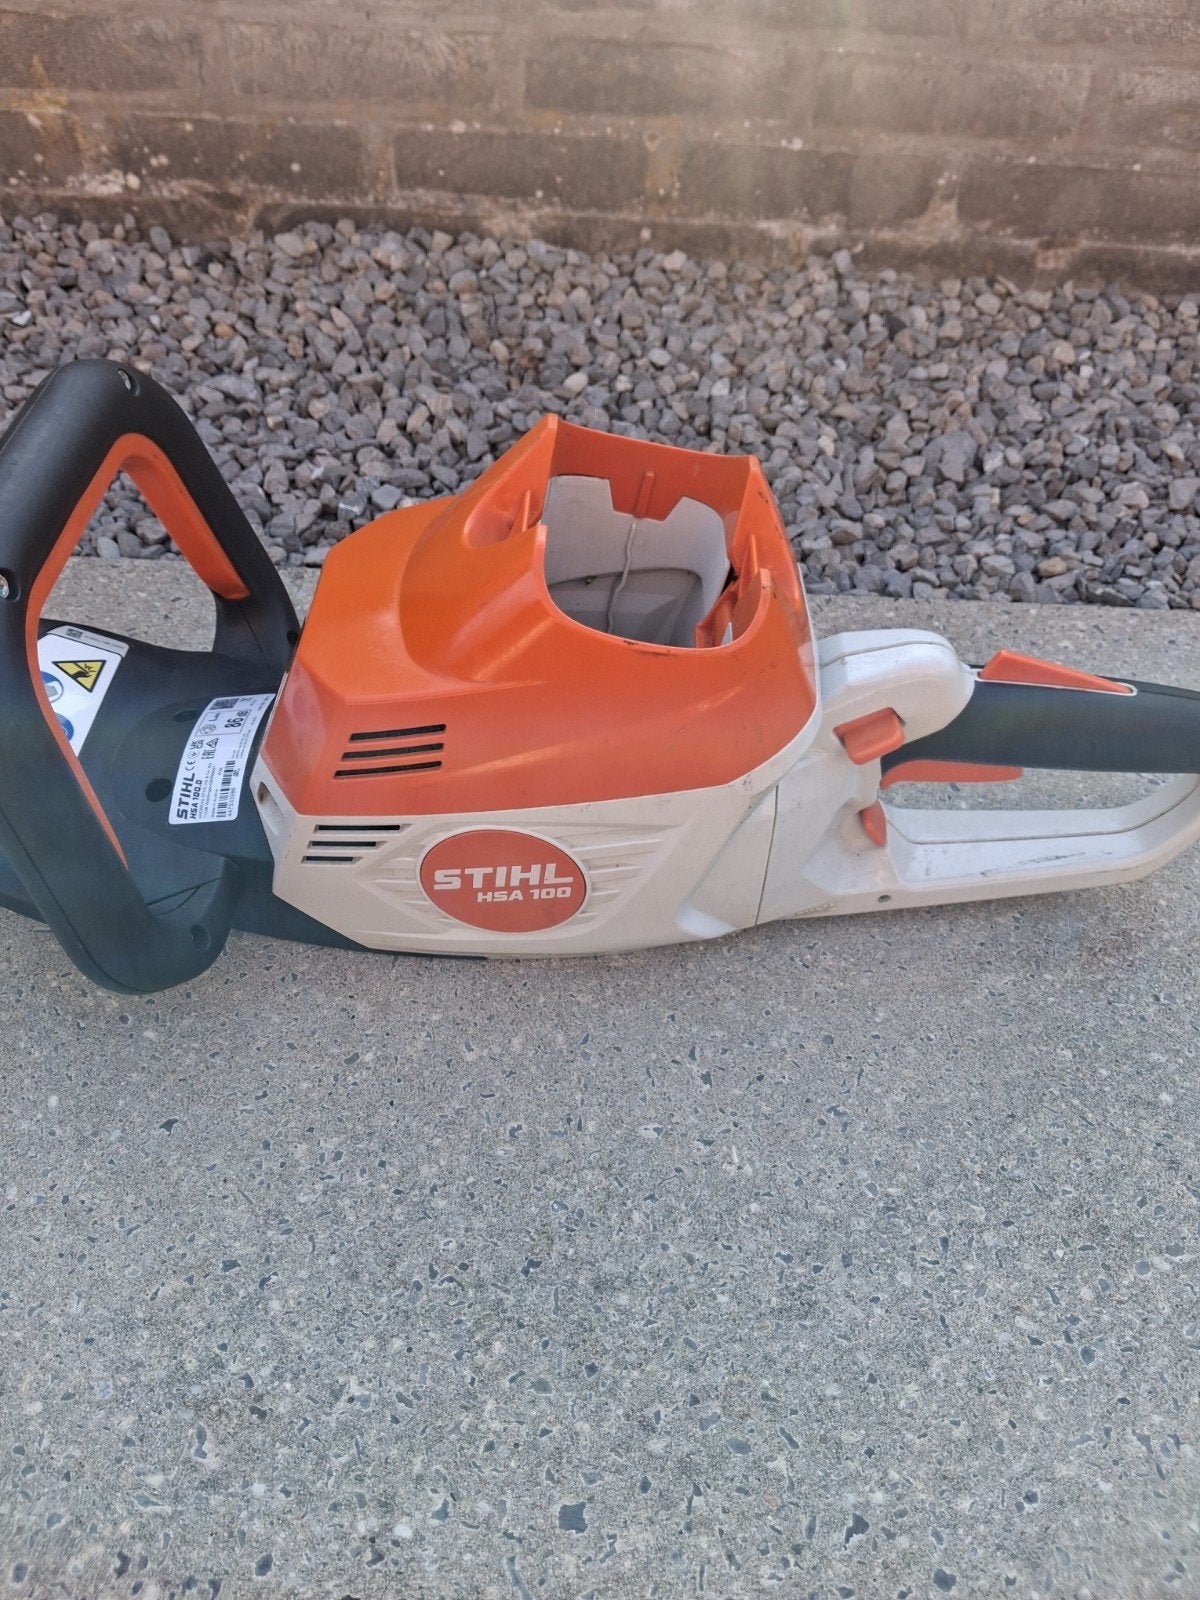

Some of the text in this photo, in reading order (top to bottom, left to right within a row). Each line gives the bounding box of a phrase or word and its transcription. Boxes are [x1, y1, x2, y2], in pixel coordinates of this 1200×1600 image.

[224, 717, 244, 728] 86
[176, 772, 195, 820] STIHL
[189, 779, 202, 819] HSA 100.0
[433, 862, 574, 891] STIHL
[476, 886, 572, 903] HSA 100
